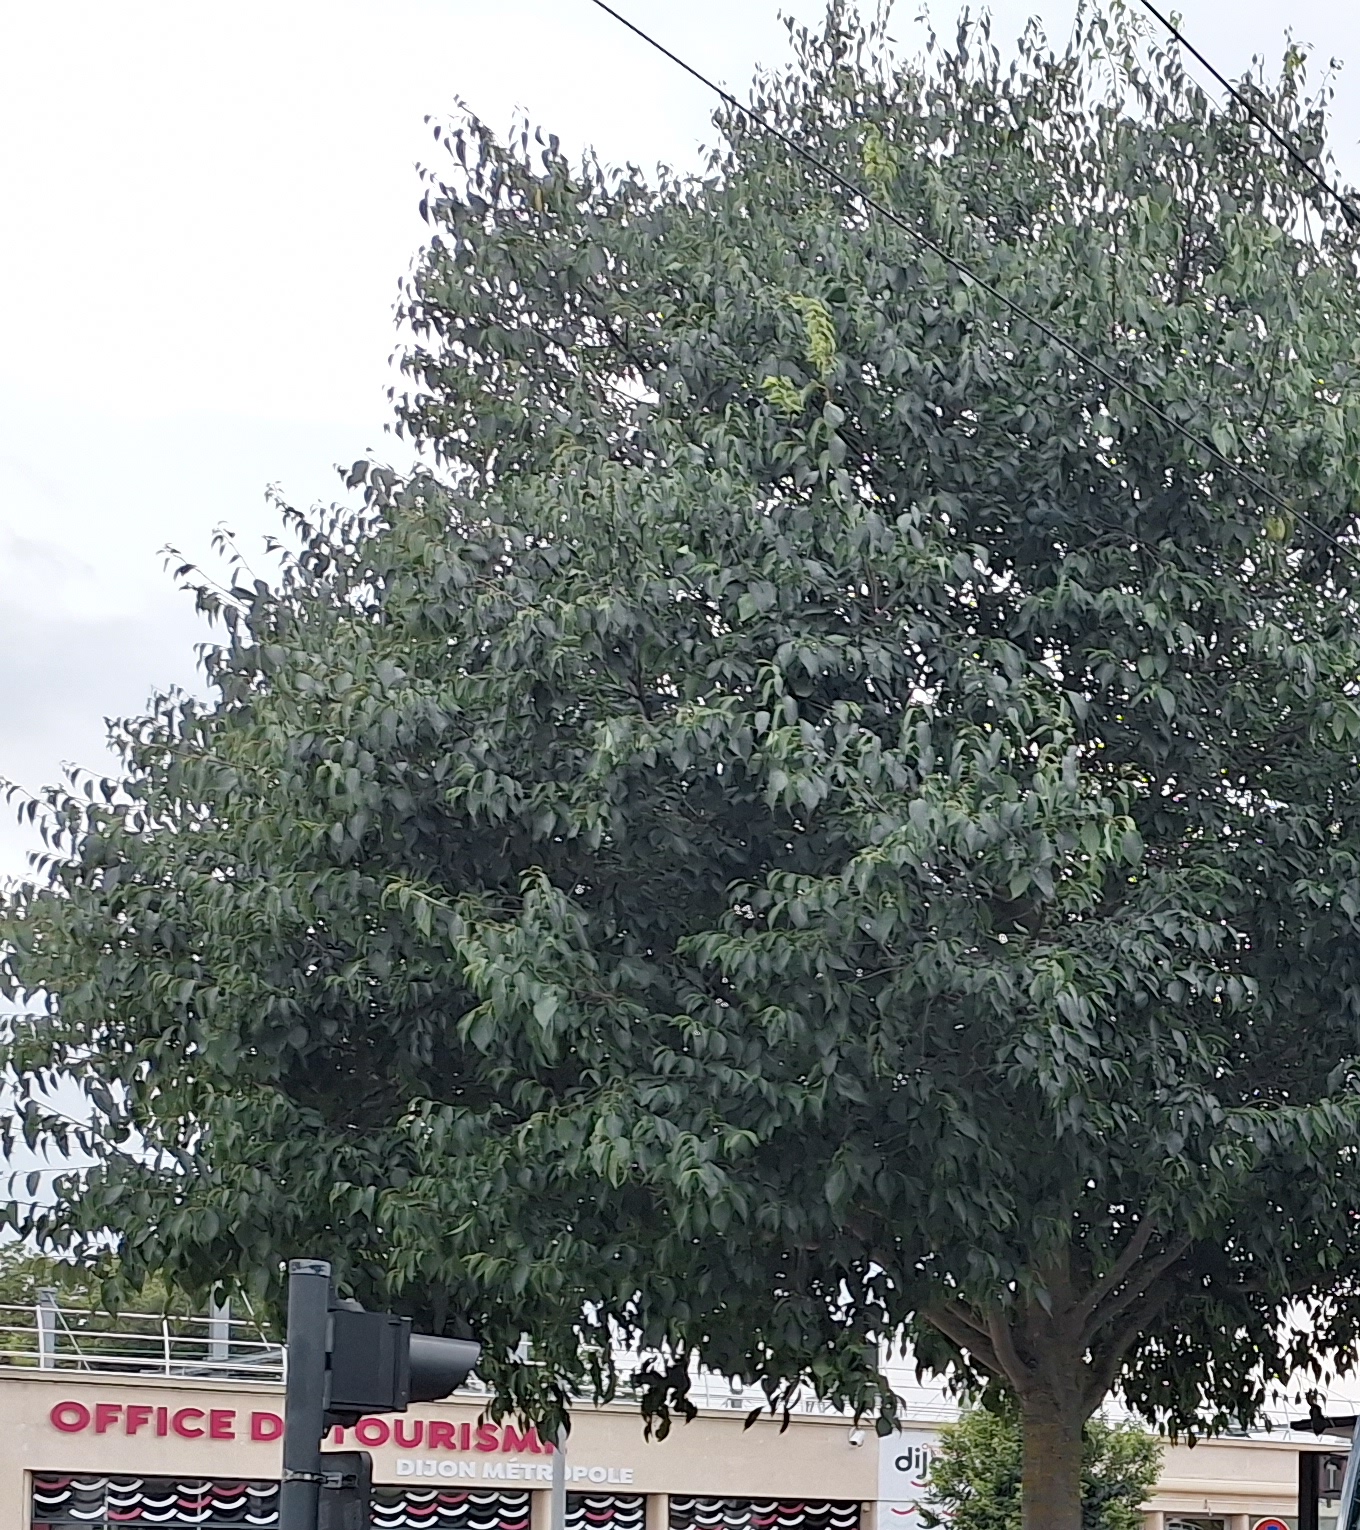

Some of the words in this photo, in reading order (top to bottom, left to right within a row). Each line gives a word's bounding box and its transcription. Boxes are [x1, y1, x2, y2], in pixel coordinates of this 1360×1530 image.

[51, 1400, 236, 1440] OFFICE
[250, 1411, 284, 1442] D
[396, 1457, 477, 1480] DIJON
